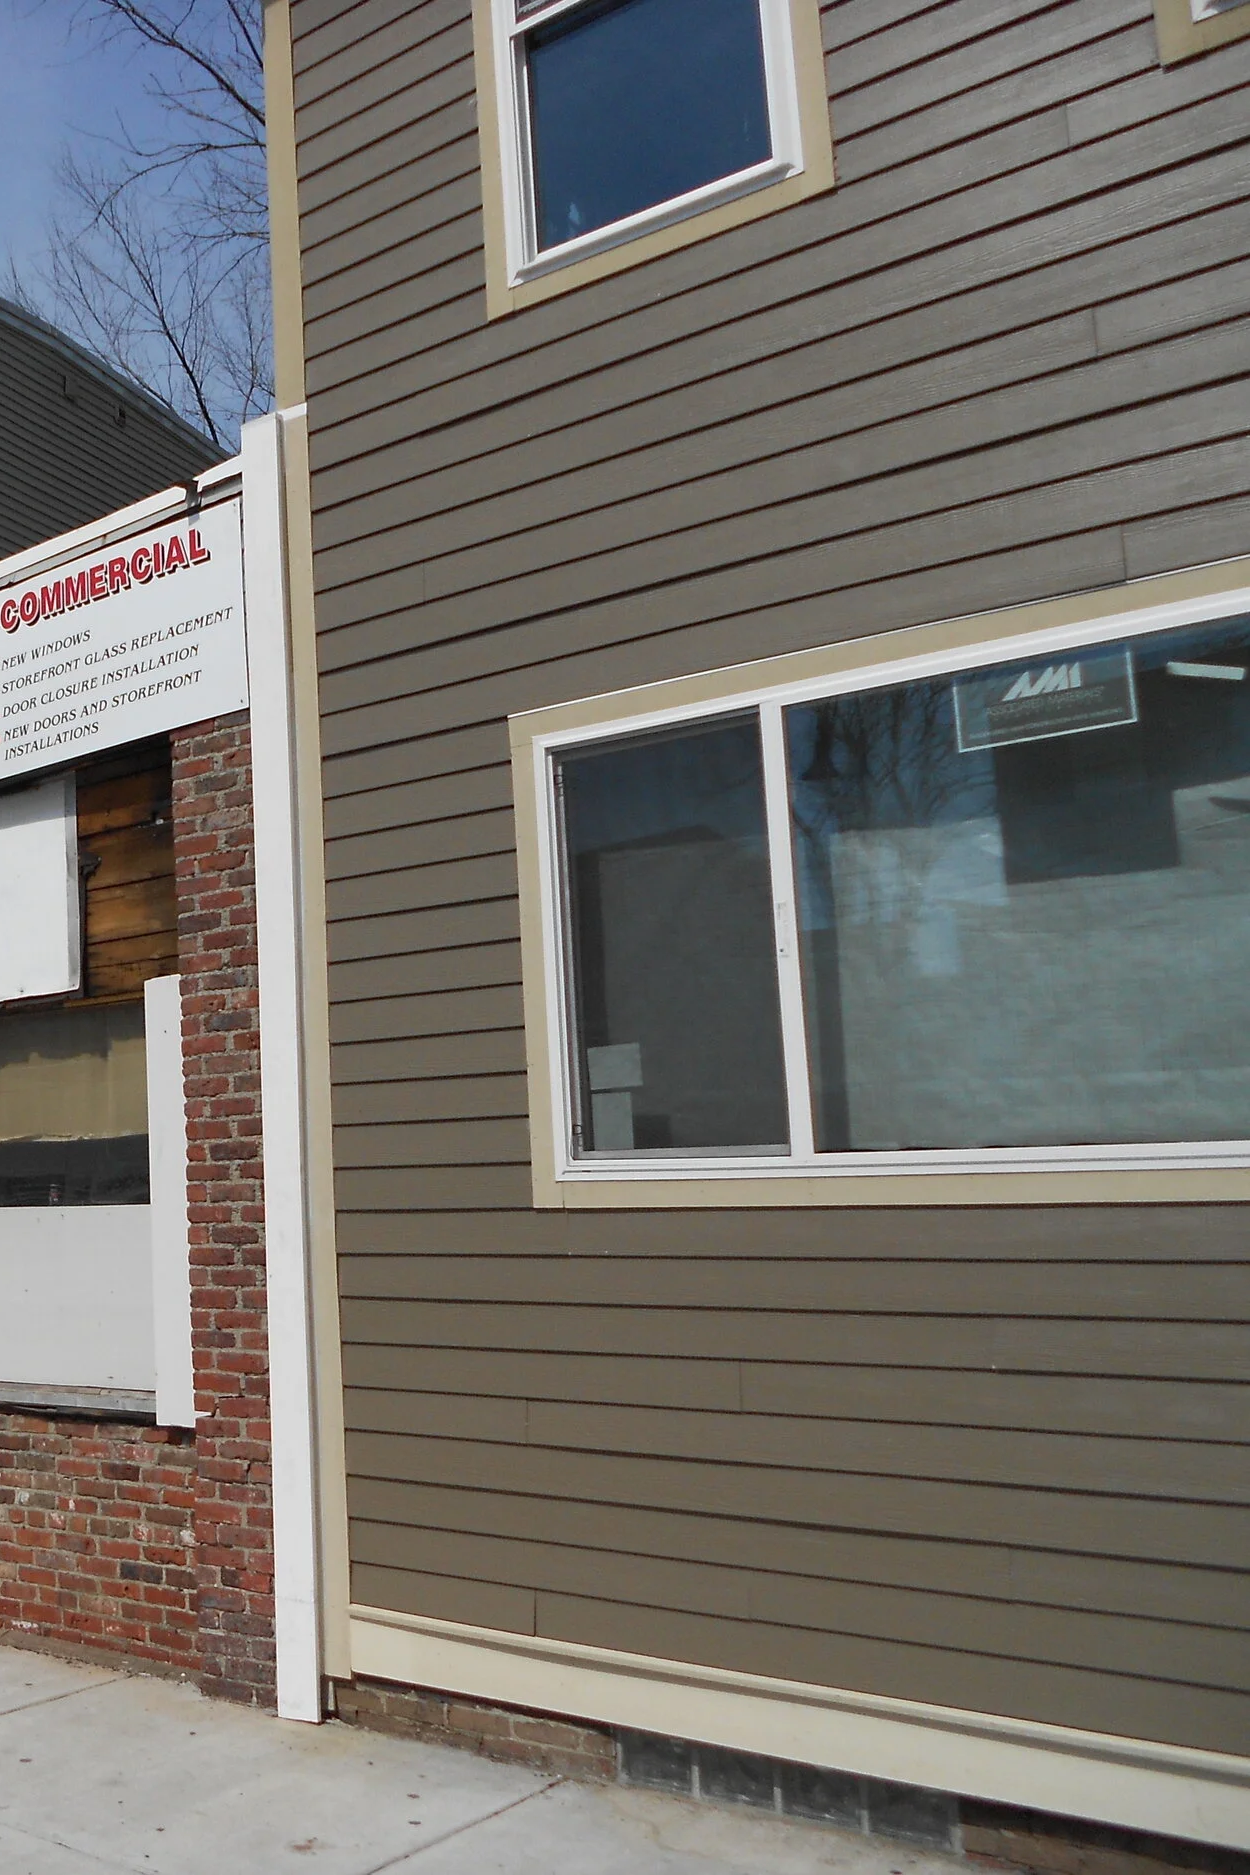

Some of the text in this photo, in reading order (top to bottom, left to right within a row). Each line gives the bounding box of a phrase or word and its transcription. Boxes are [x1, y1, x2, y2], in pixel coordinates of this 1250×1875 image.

[0, 528, 211, 633] COMMERCIAL
[1, 629, 91, 671] NEW WINDOWS
[1, 606, 233, 694] STOREFRONT GLASS REPLACEMENT
[2, 644, 199, 718] DOOR CLOSURE INSTALLATION
[3, 670, 202, 742] NEW DOORS AND STOREFRONT
[4, 721, 99, 760] INSTALLATIONS
